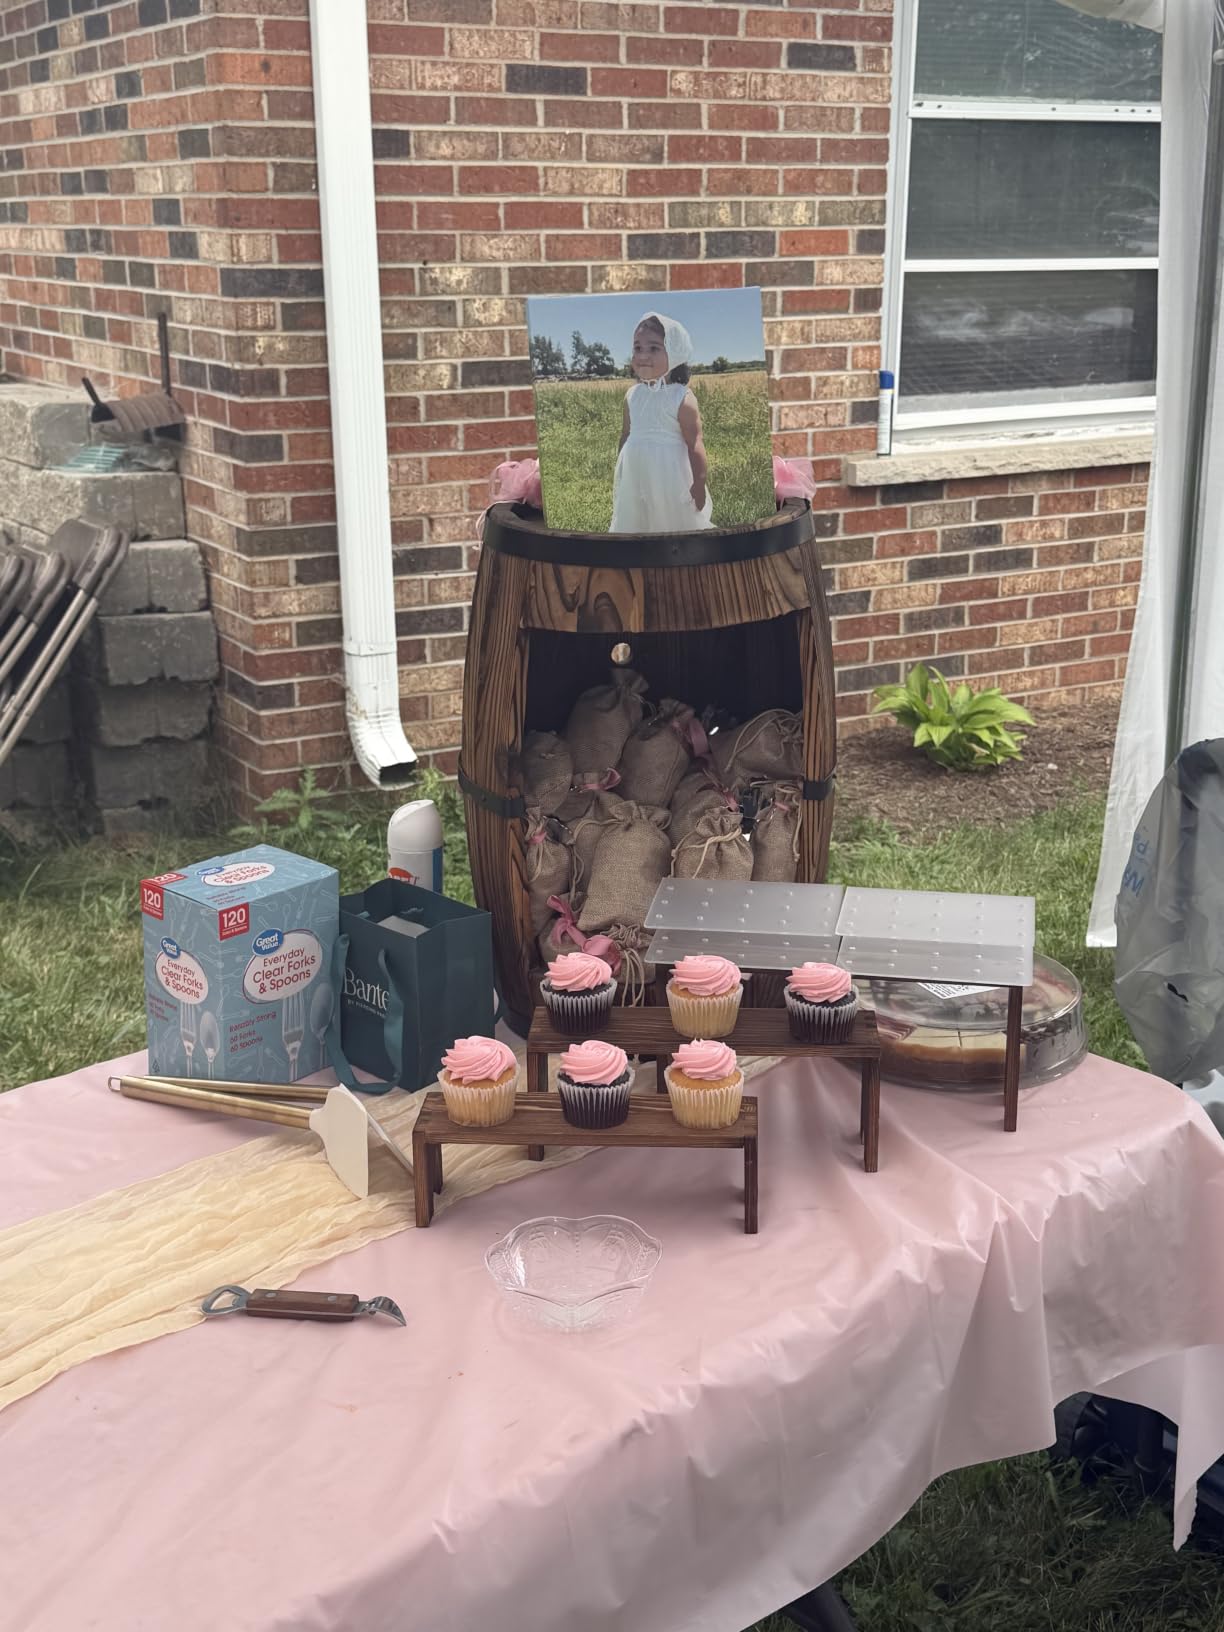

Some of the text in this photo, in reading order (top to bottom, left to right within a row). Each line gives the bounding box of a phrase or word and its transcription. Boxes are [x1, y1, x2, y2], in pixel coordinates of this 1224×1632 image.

[143, 888, 161, 908] 120
[222, 907, 246, 928] 120
[256, 932, 279, 947] Great
[261, 941, 279, 951] Value
[263, 947, 305, 967] Everyday
[161, 965, 204, 991] Clear Forks
[167, 959, 195, 978] Everyday
[253, 955, 316, 983] Clear Forks
[164, 977, 200, 999] & Spoons
[259, 969, 311, 994] & Spoons
[344, 967, 390, 1011] Bante
